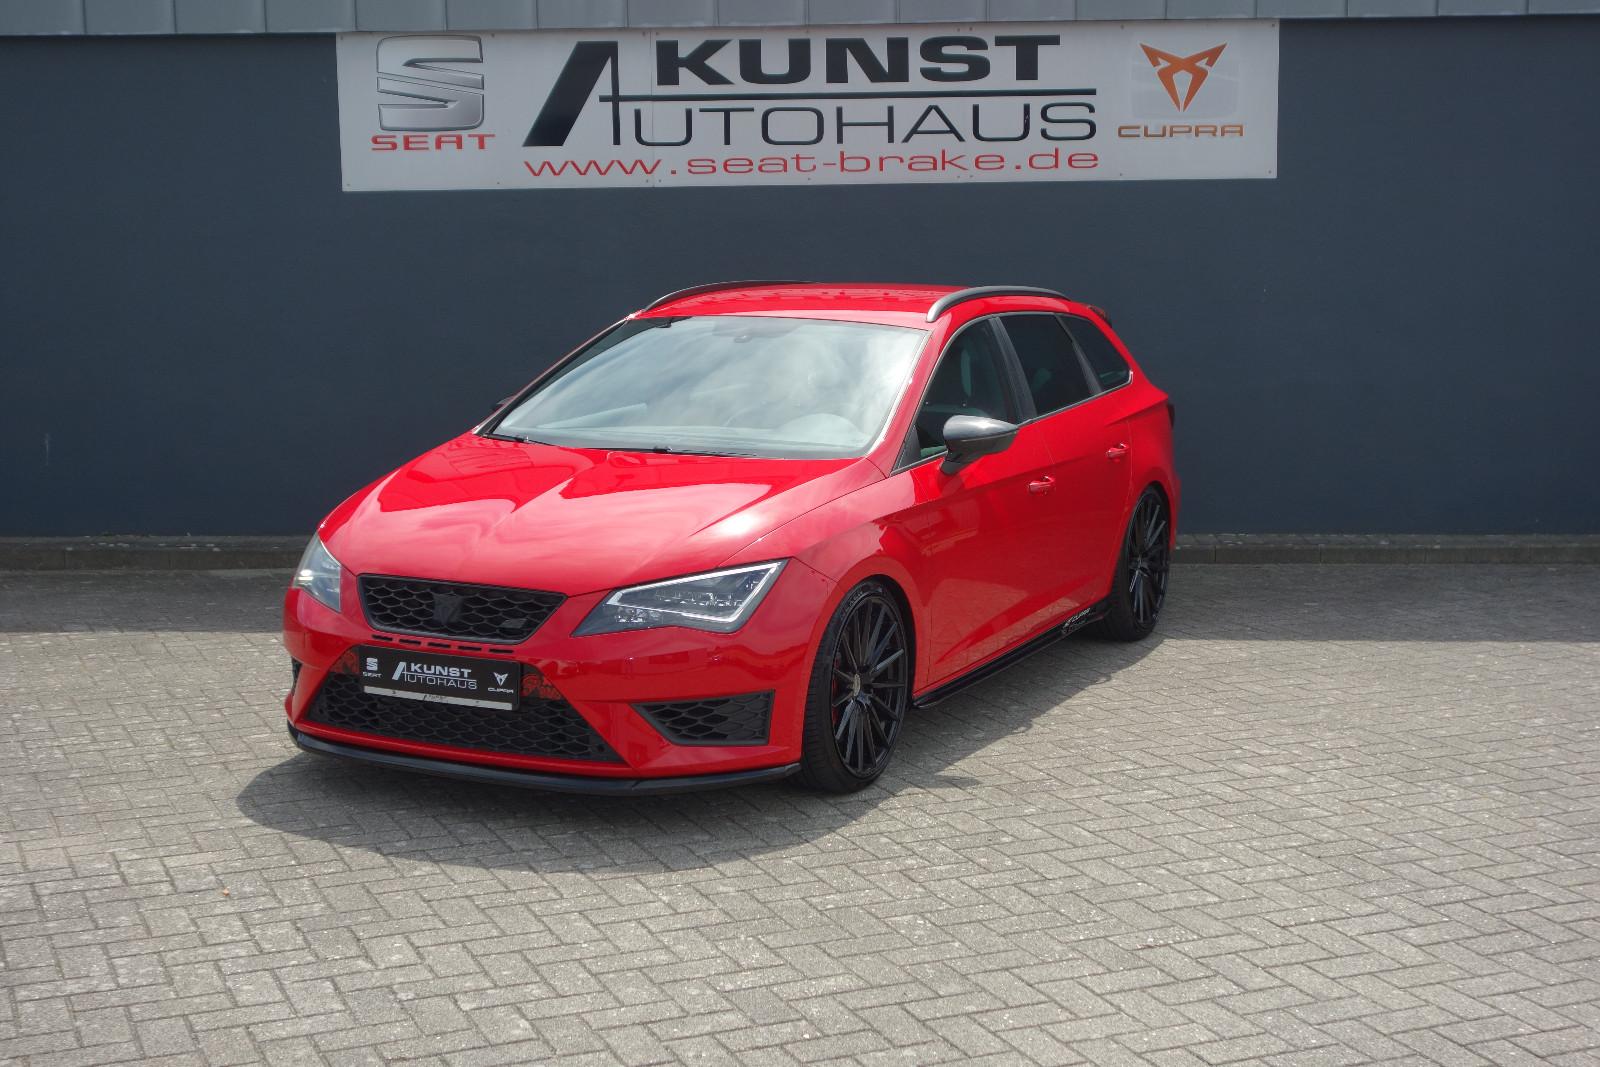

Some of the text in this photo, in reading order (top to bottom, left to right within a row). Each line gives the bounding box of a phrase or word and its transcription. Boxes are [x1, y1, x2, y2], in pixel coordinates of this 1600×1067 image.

[656, 35, 1060, 85] KUNST
[1117, 124, 1244, 138] CUPRA
[371, 133, 496, 151] SEAT
[523, 147, 1099, 177] www.seat-brake.de
[410, 662, 472, 678] KUNST
